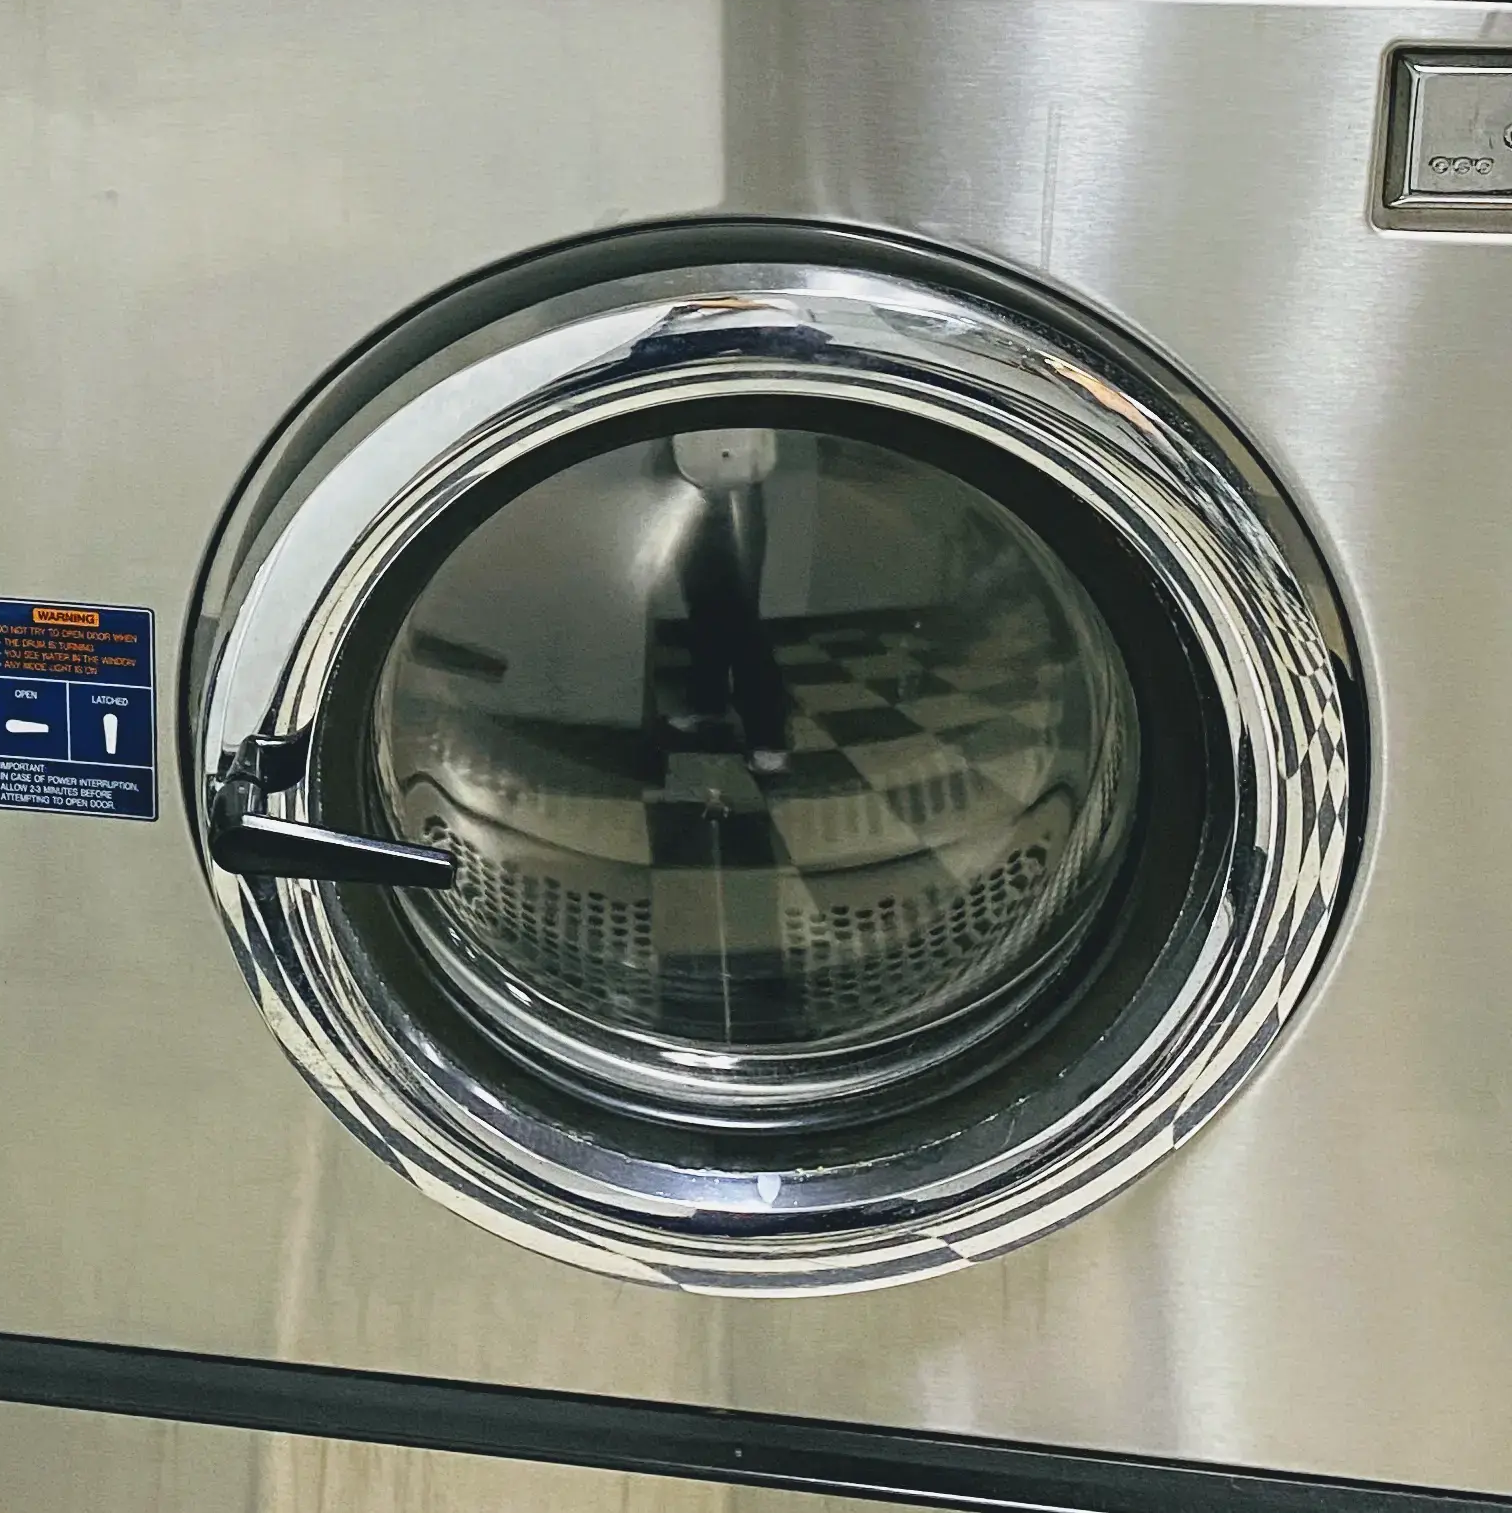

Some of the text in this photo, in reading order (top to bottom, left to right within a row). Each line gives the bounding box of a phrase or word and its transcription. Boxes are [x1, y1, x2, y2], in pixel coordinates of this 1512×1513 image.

[38, 611, 95, 624] WARNING
[15, 690, 37, 699] OPEN
[92, 695, 128, 706] LATCHED
[0, 772, 8, 780] IN
[11, 773, 31, 782] CASE
[34, 775, 45, 783] OF
[48, 776, 77, 785] POWER
[1, 783, 28, 792] ALLOW
[43, 786, 78, 796] MINUTES
[81, 788, 112, 799] BEFORE
[1, 793, 49, 804] ATTEMPTING
[52, 796, 63, 804] TO
[66, 798, 88, 807] OPEN
